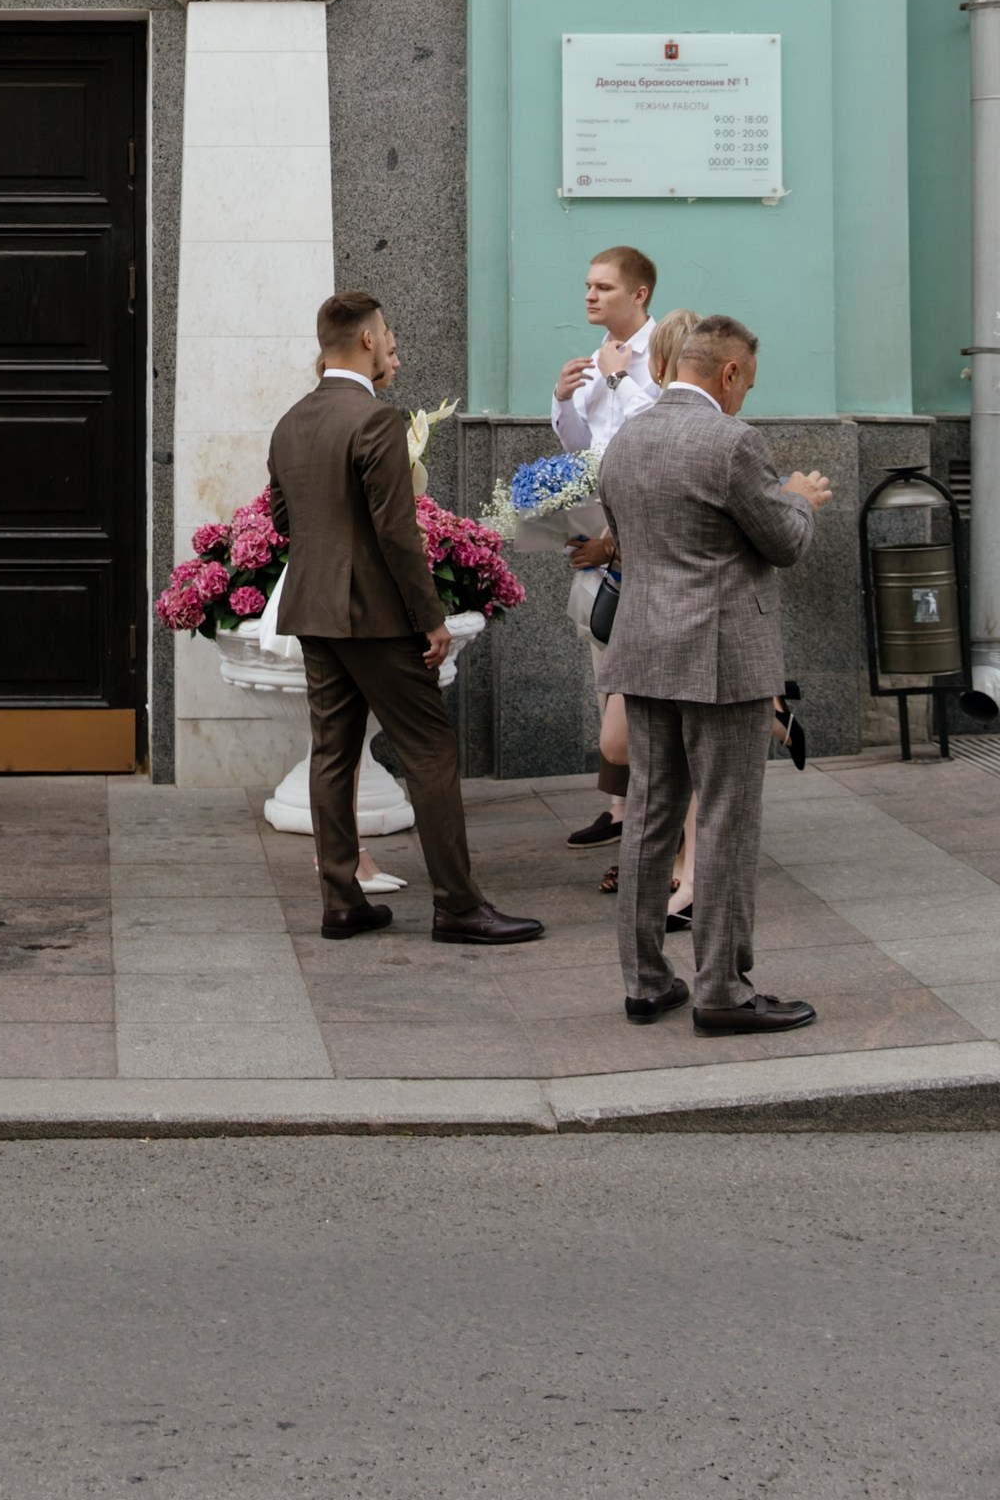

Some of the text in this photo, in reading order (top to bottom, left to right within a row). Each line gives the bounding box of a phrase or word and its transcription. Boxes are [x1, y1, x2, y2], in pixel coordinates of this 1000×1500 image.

[595, 77, 636, 88] Дворец
[638, 77, 725, 88] бракосочетания
[744, 78, 749, 86] 1
[634, 102, 709, 110] РЕЖИМ РАБОТЫ
[714, 115, 735, 124] 9:00
[744, 115, 769, 124] 18:00
[714, 129, 735, 137] 9:00
[742, 129, 769, 137] 20:00
[714, 143, 735, 152] 9:00
[742, 143, 769, 152] 23:59
[708, 157, 735, 166] 00:00
[744, 157, 769, 166] 19:00
